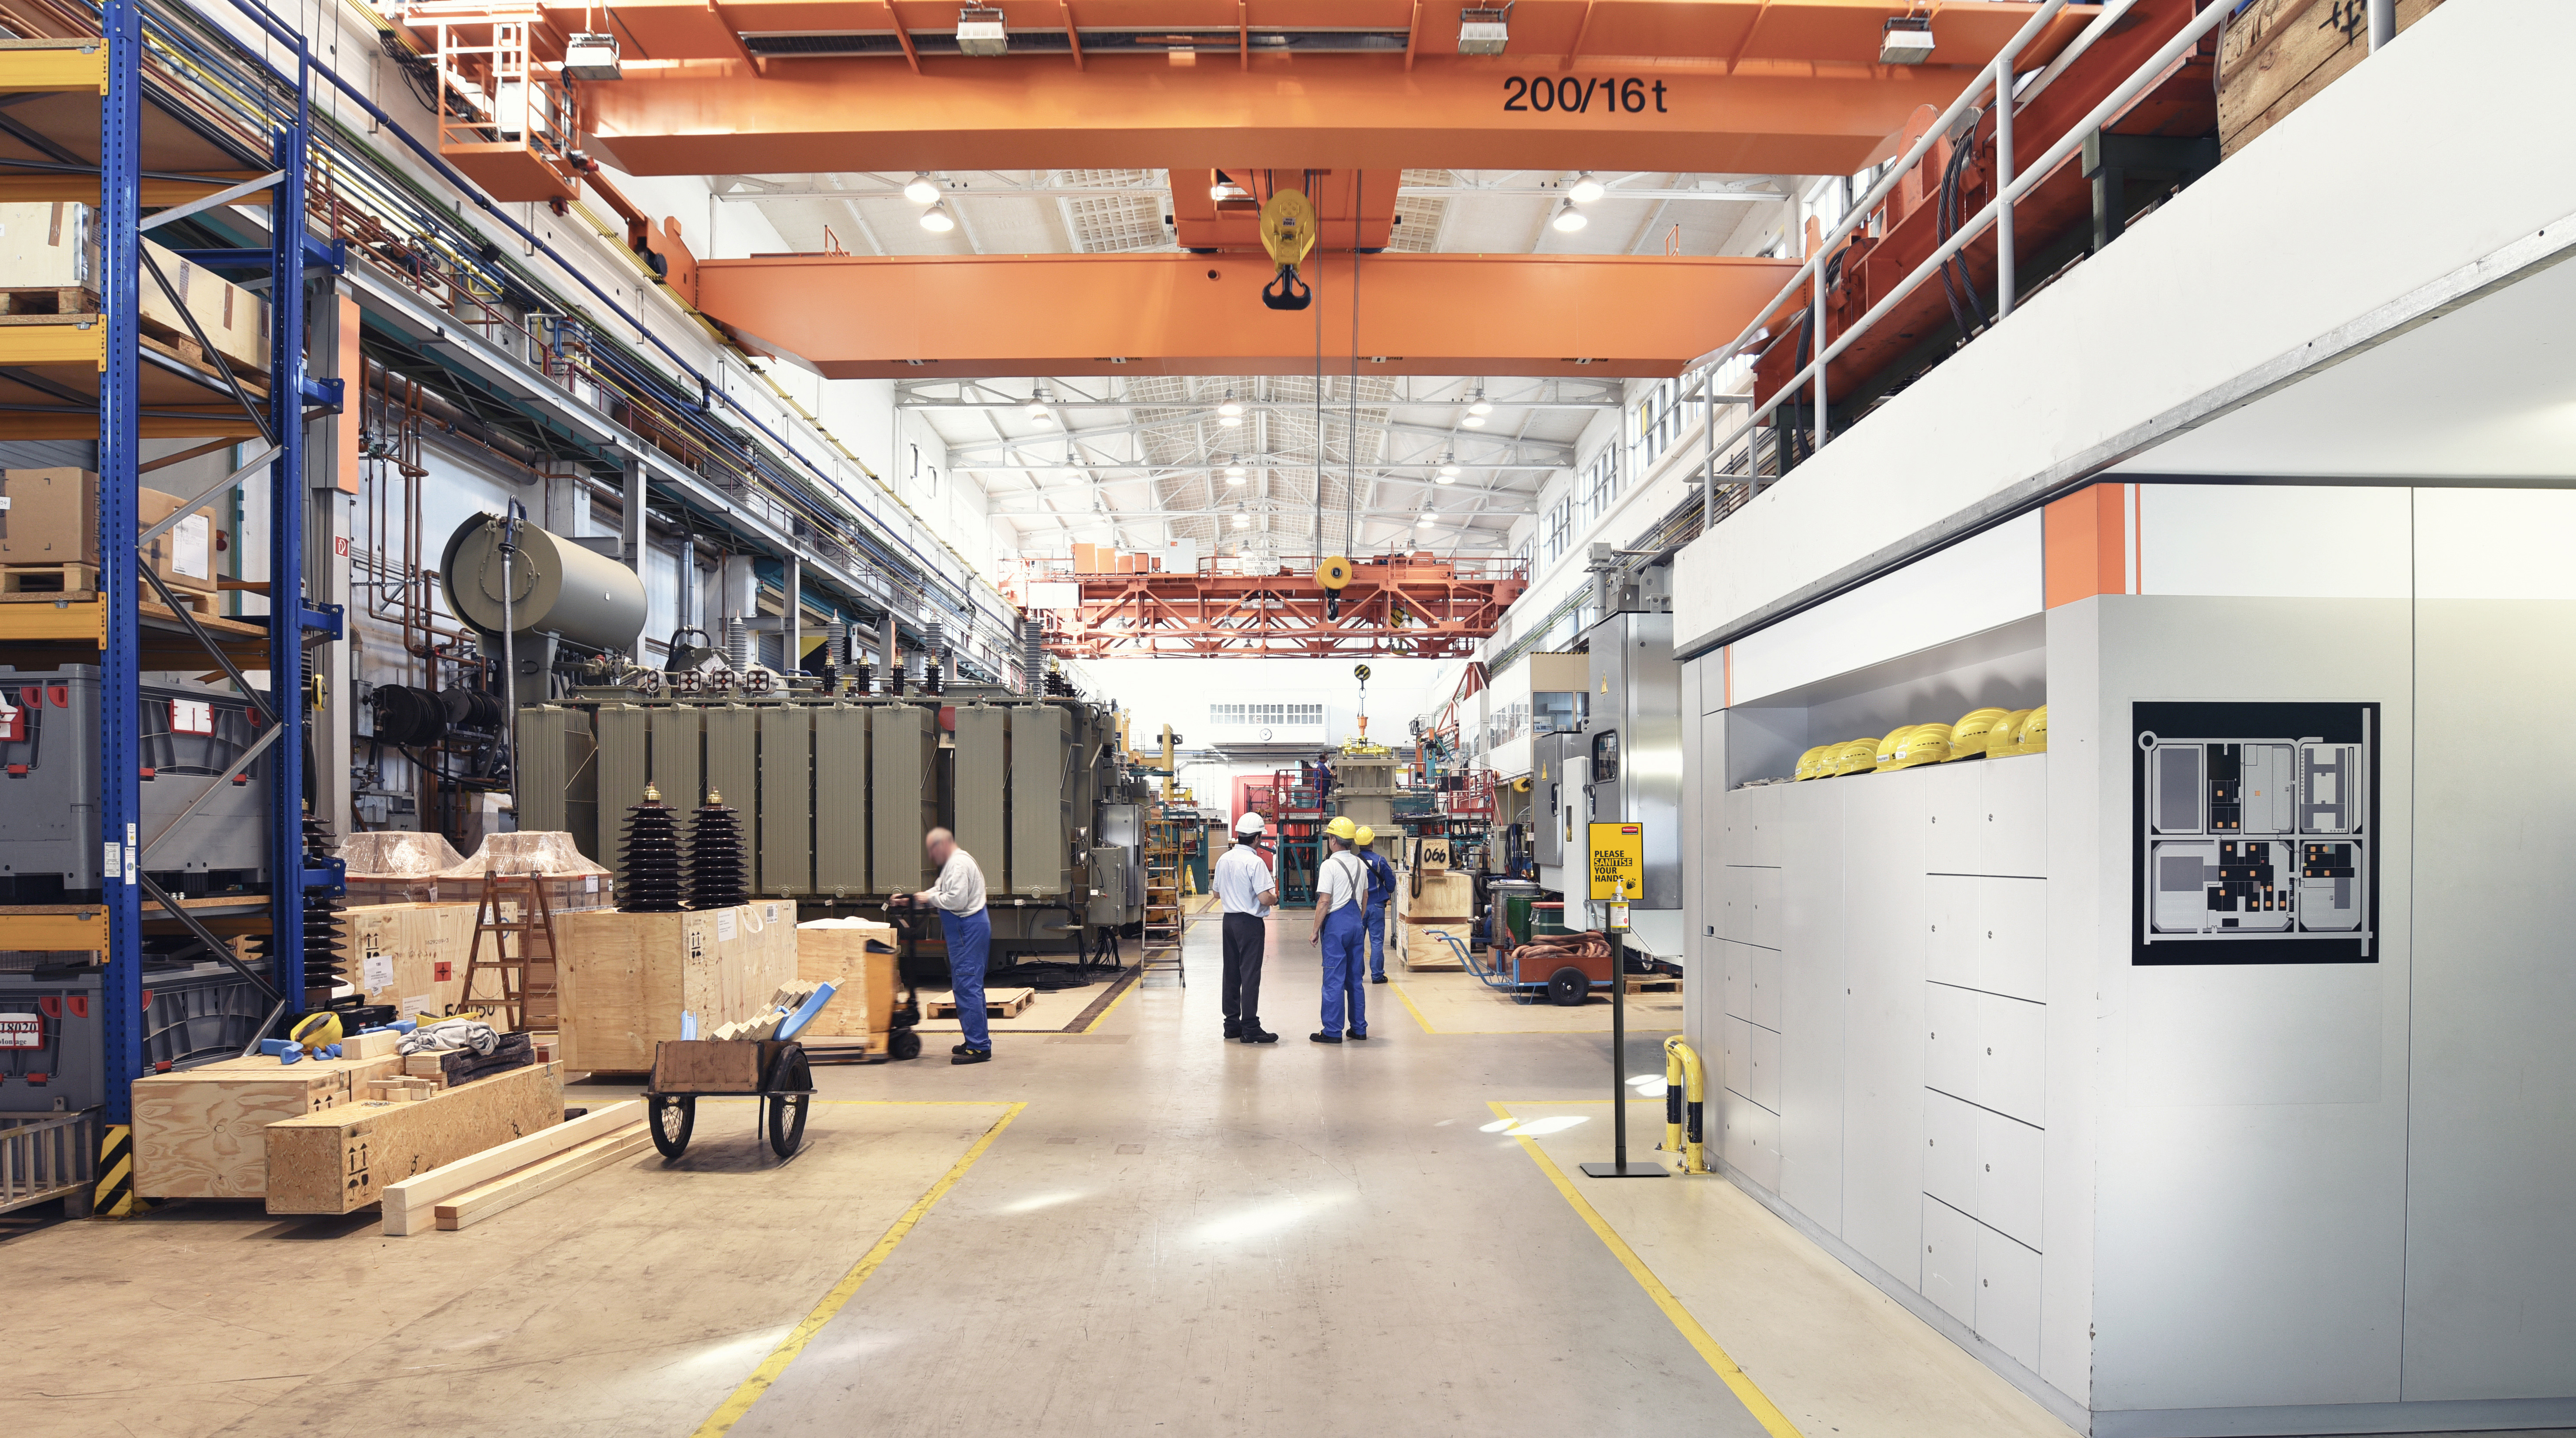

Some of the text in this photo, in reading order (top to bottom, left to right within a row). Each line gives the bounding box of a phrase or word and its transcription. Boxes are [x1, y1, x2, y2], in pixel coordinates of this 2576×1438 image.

[1504, 76, 1667, 113] 200/16 t
[1424, 848, 1446, 863] 066
[1594, 858, 1632, 866] SANITISE
